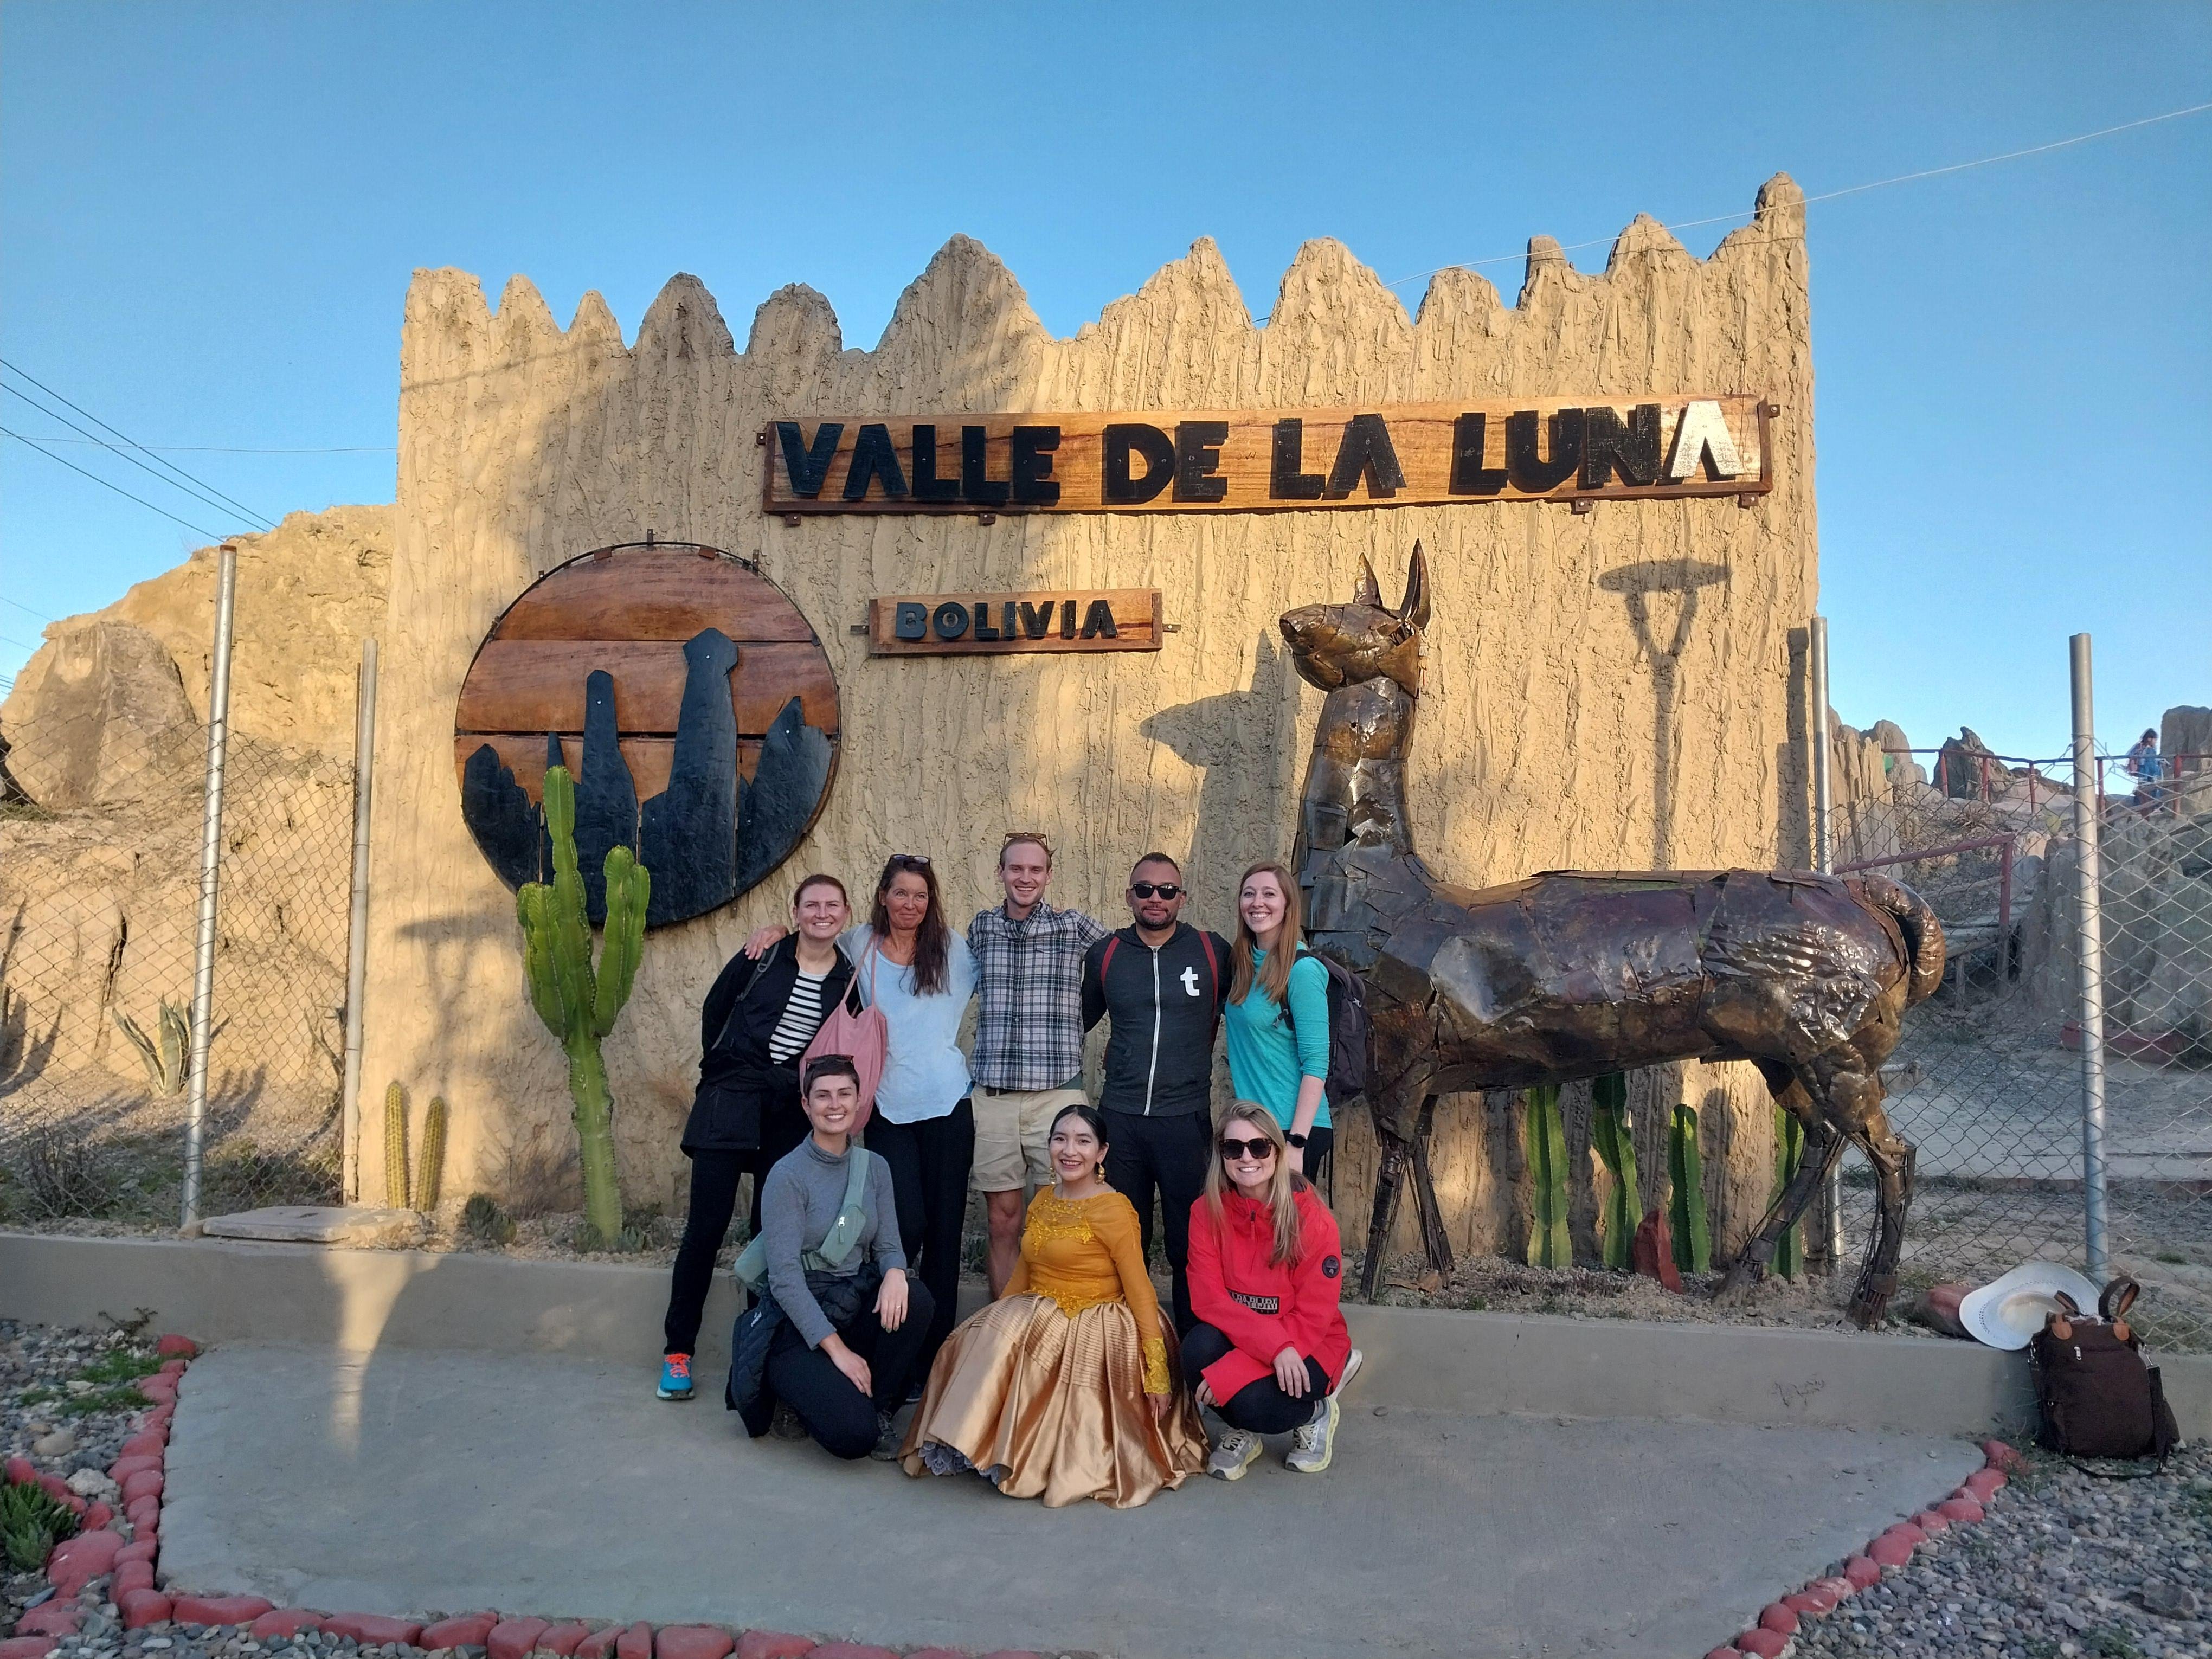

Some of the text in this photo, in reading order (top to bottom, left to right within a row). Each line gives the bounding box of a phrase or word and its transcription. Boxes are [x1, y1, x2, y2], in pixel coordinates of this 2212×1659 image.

[776, 400, 1745, 503] VALLE DE LA LUNA
[895, 599, 1117, 640] BOLIVIA
[1180, 966, 1200, 996] t
